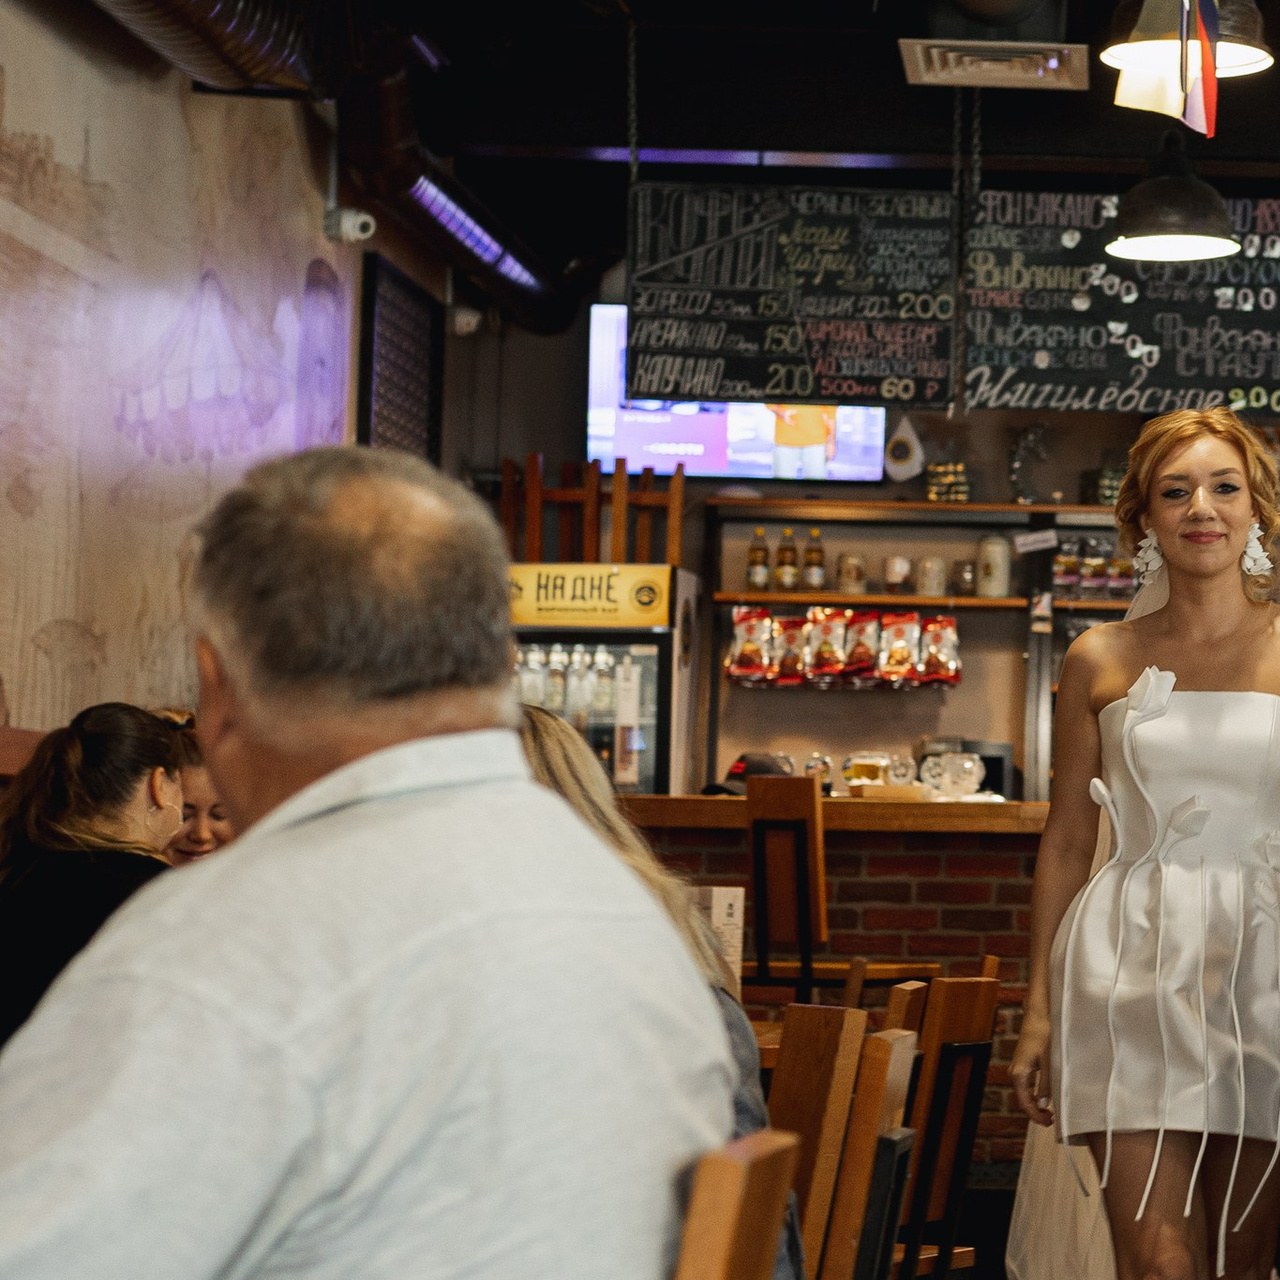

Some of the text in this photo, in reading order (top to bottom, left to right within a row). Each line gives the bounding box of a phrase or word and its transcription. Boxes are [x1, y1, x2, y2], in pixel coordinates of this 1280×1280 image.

[897, 292, 955, 320] 200
[1213, 286, 1278, 312] 200
[764, 324, 804, 354] 150
[765, 362, 813, 398] 200
[880, 376, 916, 401] 60
[963, 362, 1226, 417] Жигулёвское
[570, 572, 620, 604] ДНЕ
